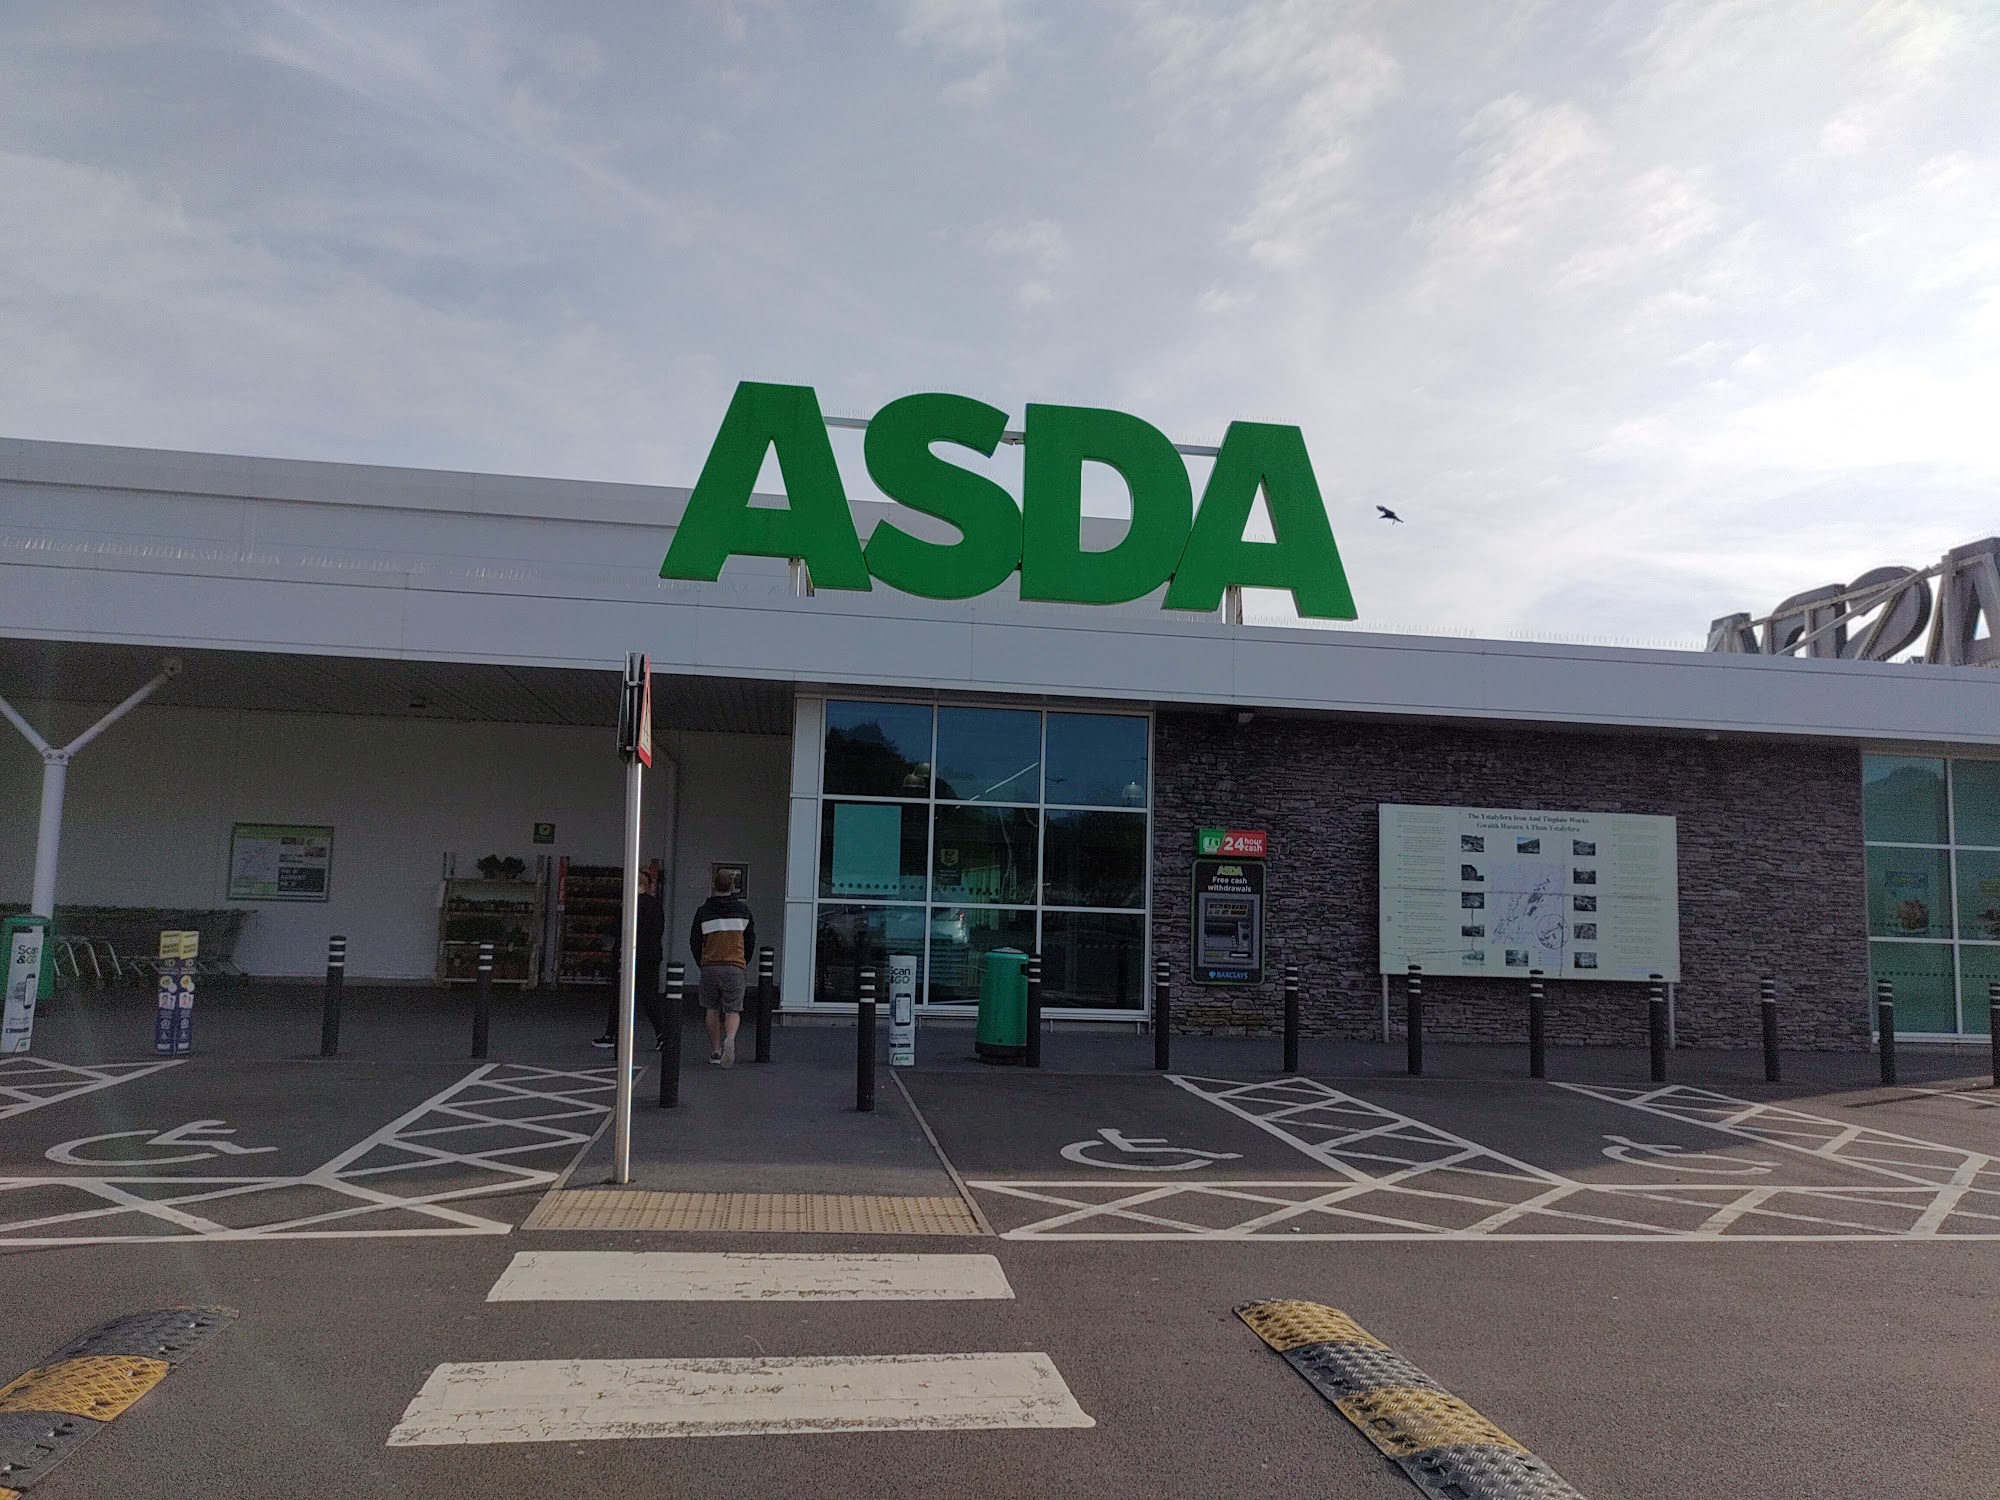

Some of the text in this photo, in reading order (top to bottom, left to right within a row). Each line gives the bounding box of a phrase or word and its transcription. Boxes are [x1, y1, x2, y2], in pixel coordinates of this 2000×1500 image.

[658, 380, 1358, 620] ASDA
[1468, 812, 1479, 820] The
[1223, 837, 1244, 851] 24
[1244, 837, 1263, 847] hour
[1244, 845, 1263, 853] cash
[1212, 876, 1248, 885] Free cash
[1207, 884, 1252, 893] withdrawals
[18, 944, 38, 955] Scan
